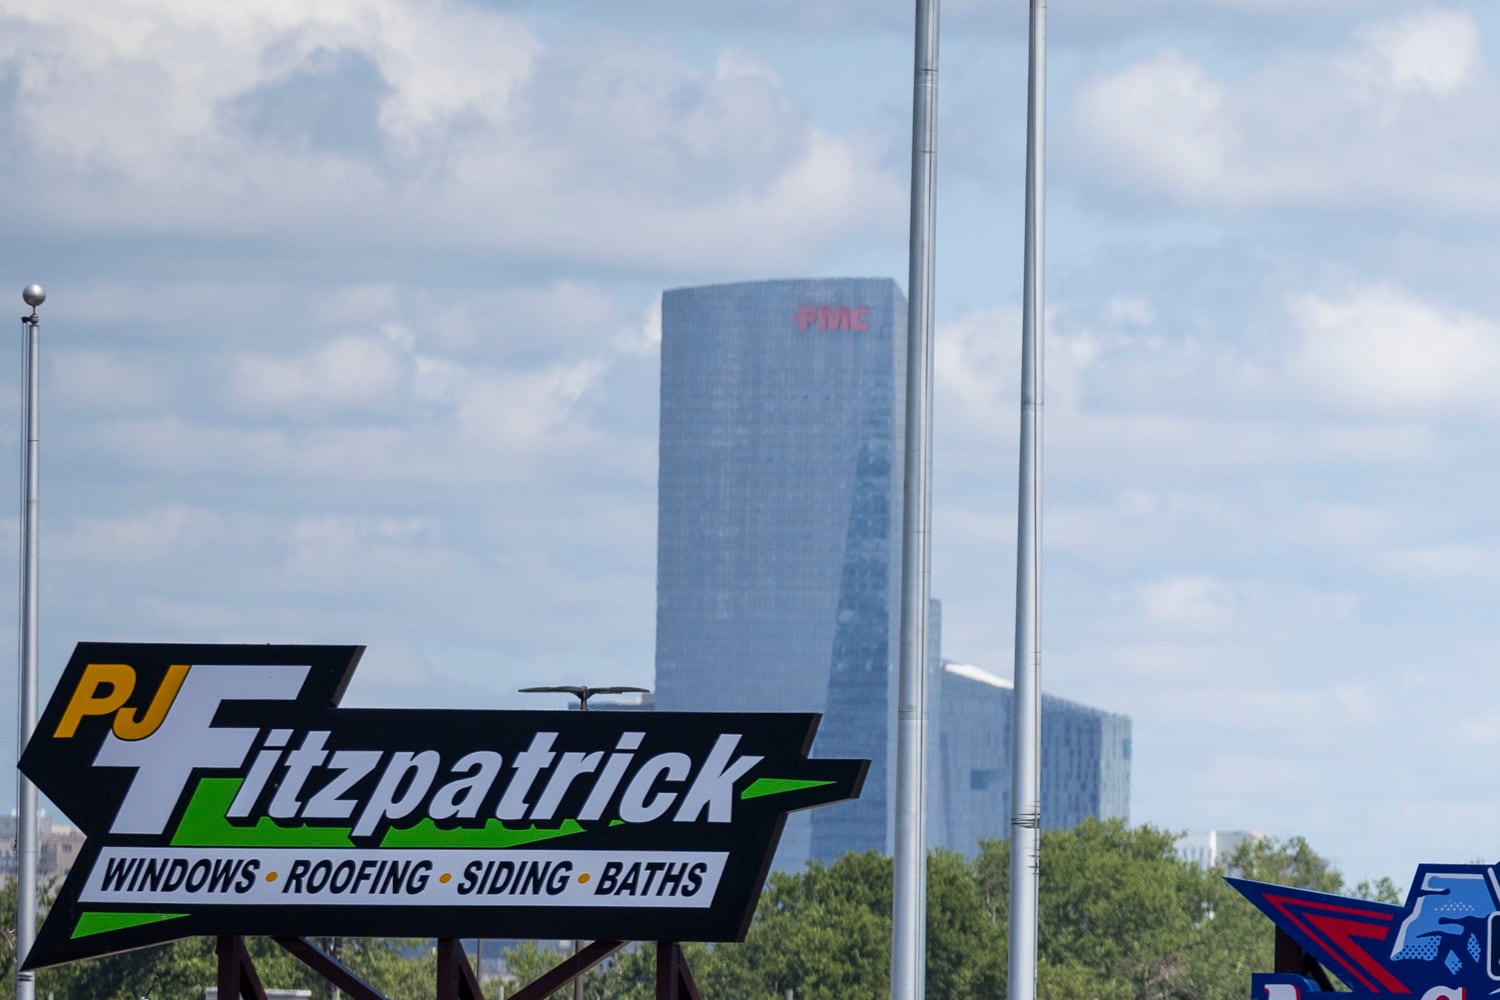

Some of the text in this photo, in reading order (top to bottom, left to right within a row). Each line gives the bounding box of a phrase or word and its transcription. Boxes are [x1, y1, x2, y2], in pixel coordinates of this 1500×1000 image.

[793, 305, 869, 331] FMC
[54, 664, 764, 836] PJ Fitzpatrick
[99, 858, 707, 897] WINDOWS ROOFING SIDING BATHS
